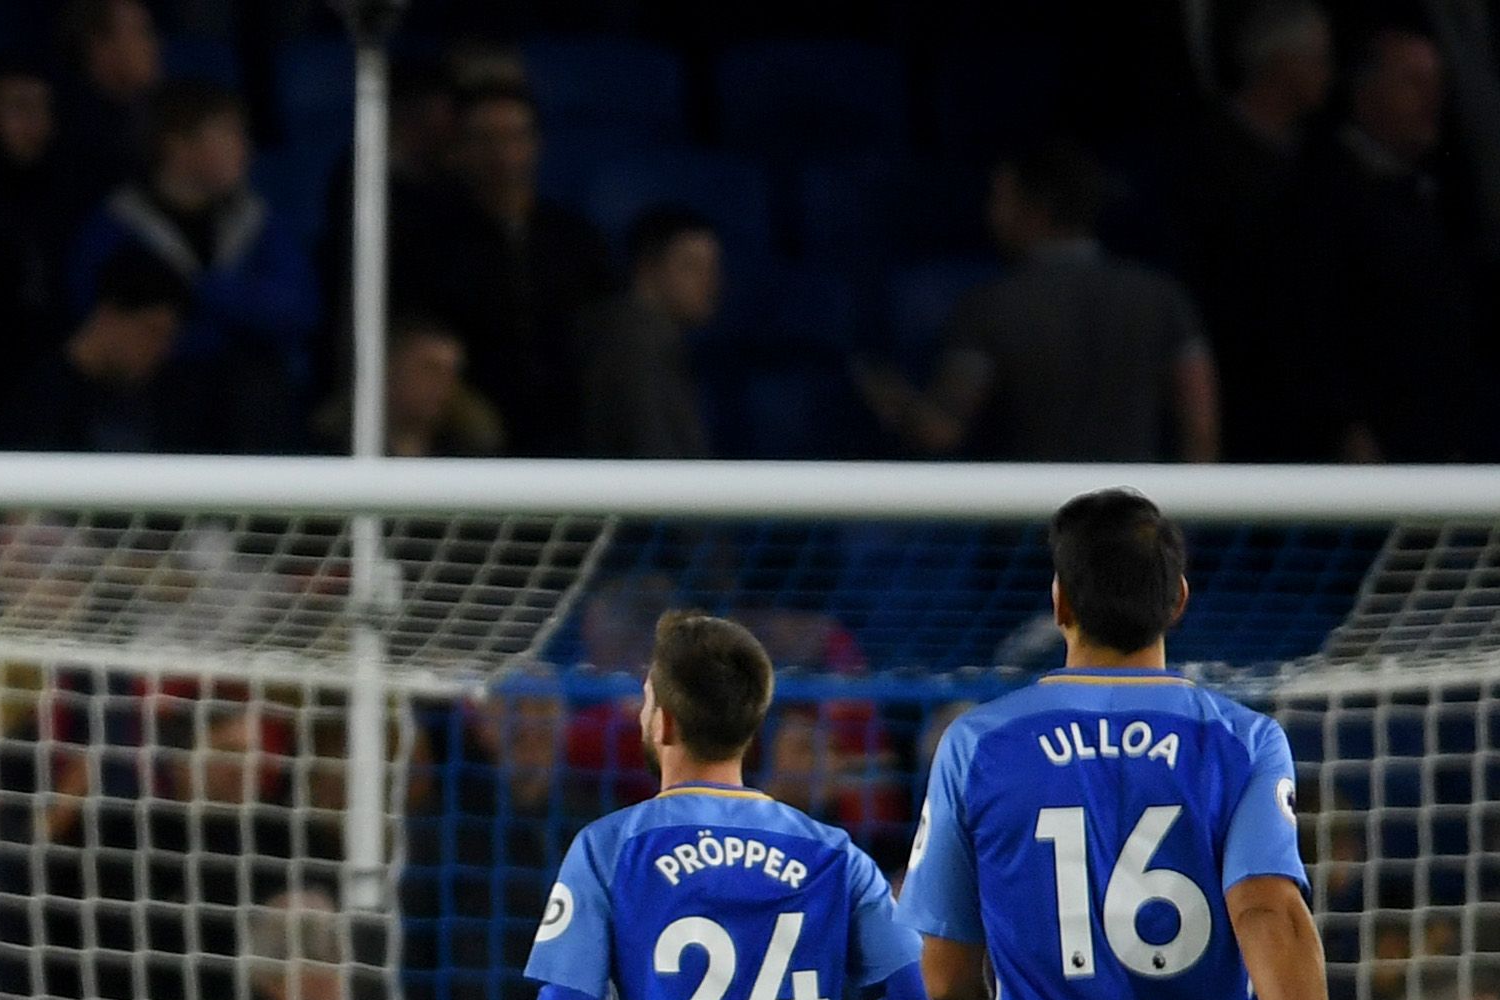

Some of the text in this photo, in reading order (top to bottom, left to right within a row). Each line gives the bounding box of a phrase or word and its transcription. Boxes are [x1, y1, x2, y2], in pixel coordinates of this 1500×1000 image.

[1038, 719, 1180, 769] ULLOA
[655, 829, 808, 889] PRÖPPER
[1035, 805, 1212, 980] 16
